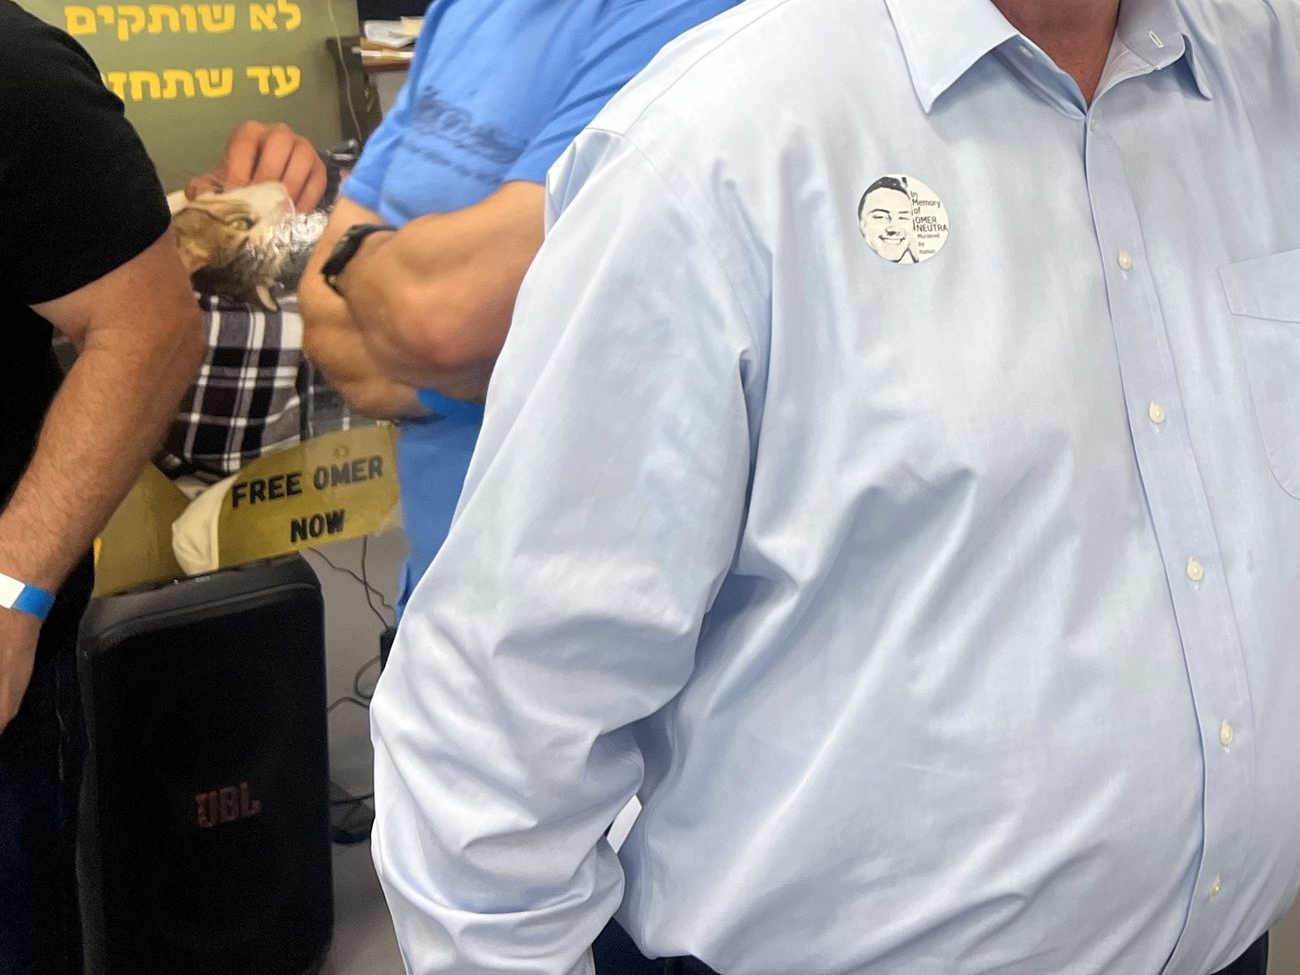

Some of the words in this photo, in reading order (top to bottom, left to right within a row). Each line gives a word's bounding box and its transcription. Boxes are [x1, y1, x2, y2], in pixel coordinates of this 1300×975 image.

[64, 3, 236, 42] שותקים
[103, 67, 234, 102] שתחז
[246, 64, 301, 99] עד
[912, 198, 941, 209] Memory
[915, 216, 937, 224] OMER
[916, 224, 949, 232] NEUTRA
[232, 472, 302, 509] FREE
[313, 455, 384, 491] OMER
[290, 509, 346, 544] NOW
[195, 780, 263, 828] JBL
